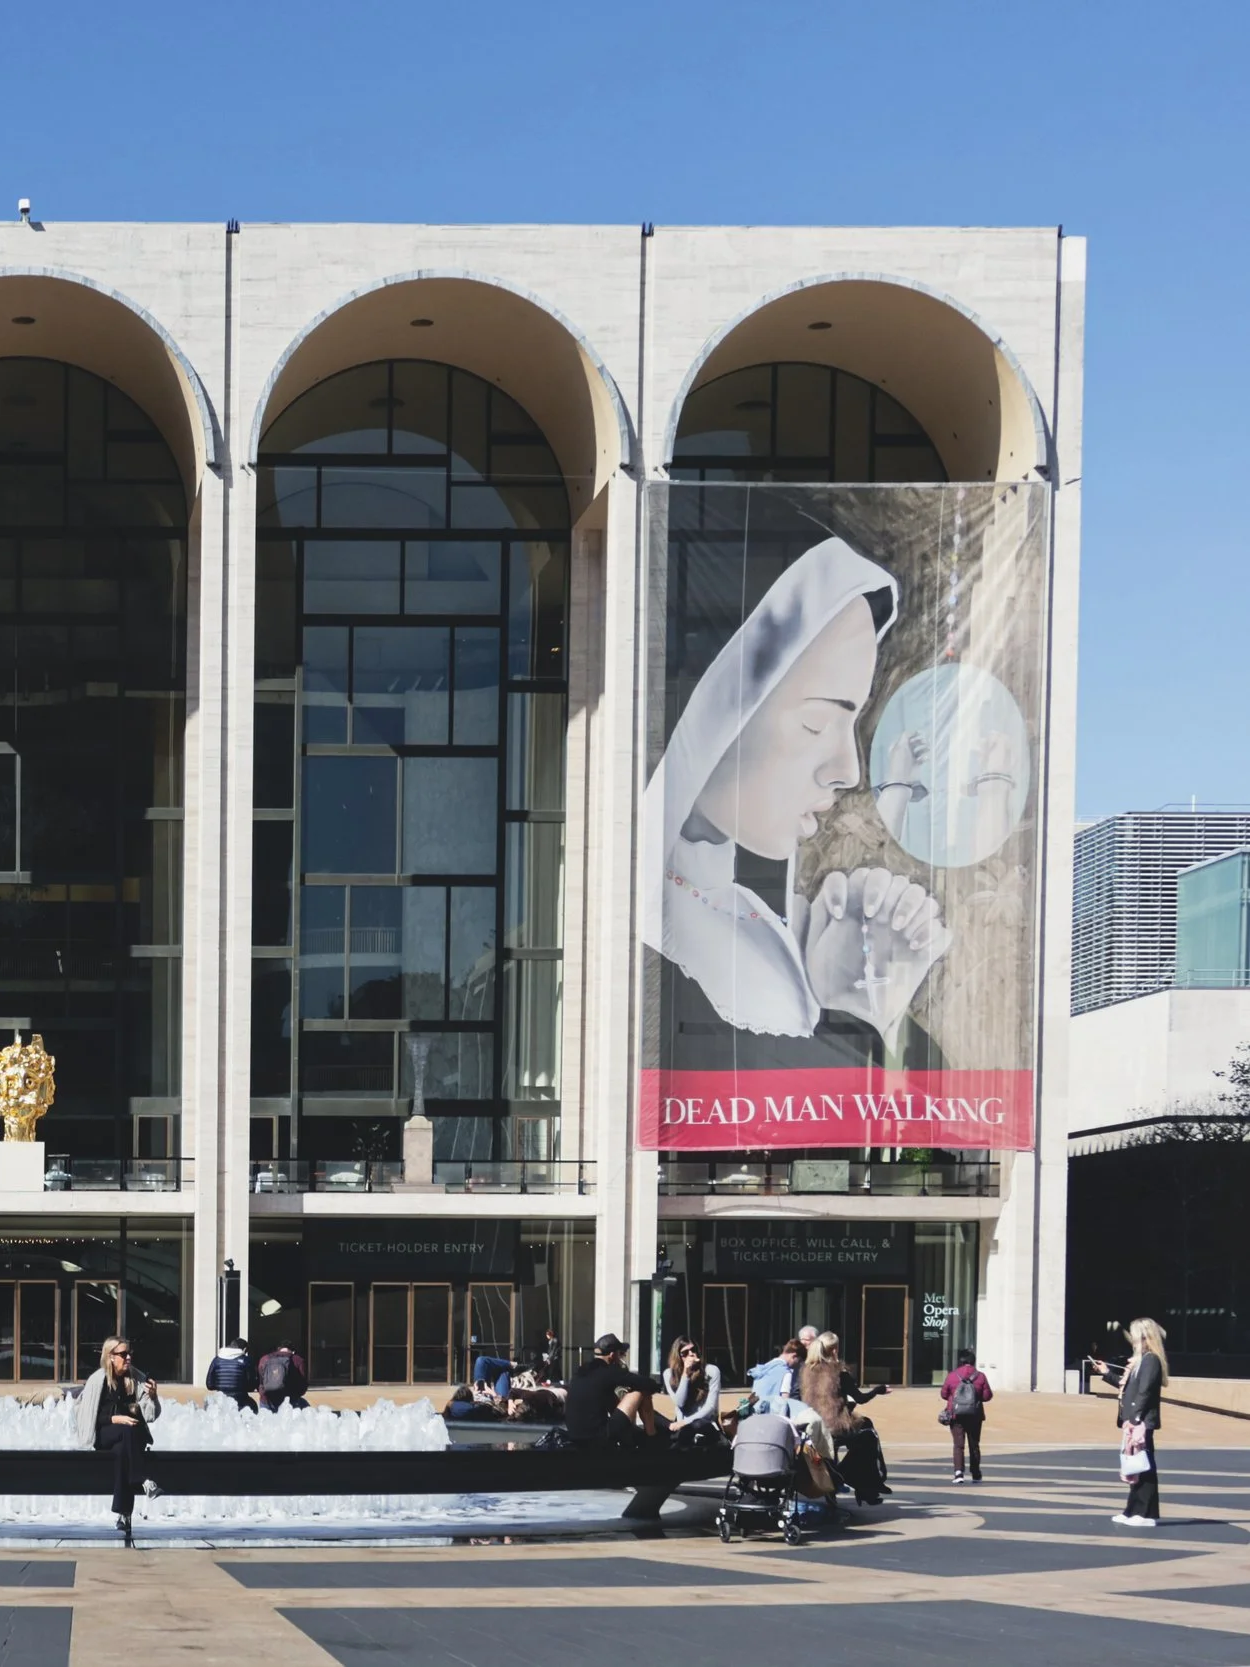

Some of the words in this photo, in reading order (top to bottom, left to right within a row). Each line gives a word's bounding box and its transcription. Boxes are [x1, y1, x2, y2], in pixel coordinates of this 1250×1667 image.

[663, 1096, 756, 1125] DEAD
[763, 1094, 844, 1123] MAN
[852, 1094, 1006, 1125] WALKING
[337, 1241, 439, 1253] TICKET-HOLDER
[444, 1243, 485, 1254] ENTRY
[720, 1237, 747, 1248] BOX
[751, 1237, 801, 1249] OFFICE,
[806, 1238, 836, 1249] WILL
[840, 1238, 877, 1250] CALL,
[881, 1238, 892, 1249] &
[732, 1251, 833, 1262] TICKET-HOLDER
[837, 1252, 879, 1263] ENTRY
[923, 1292, 946, 1304] Met
[923, 1303, 960, 1319] Opera
[922, 1315, 949, 1330] Shop
